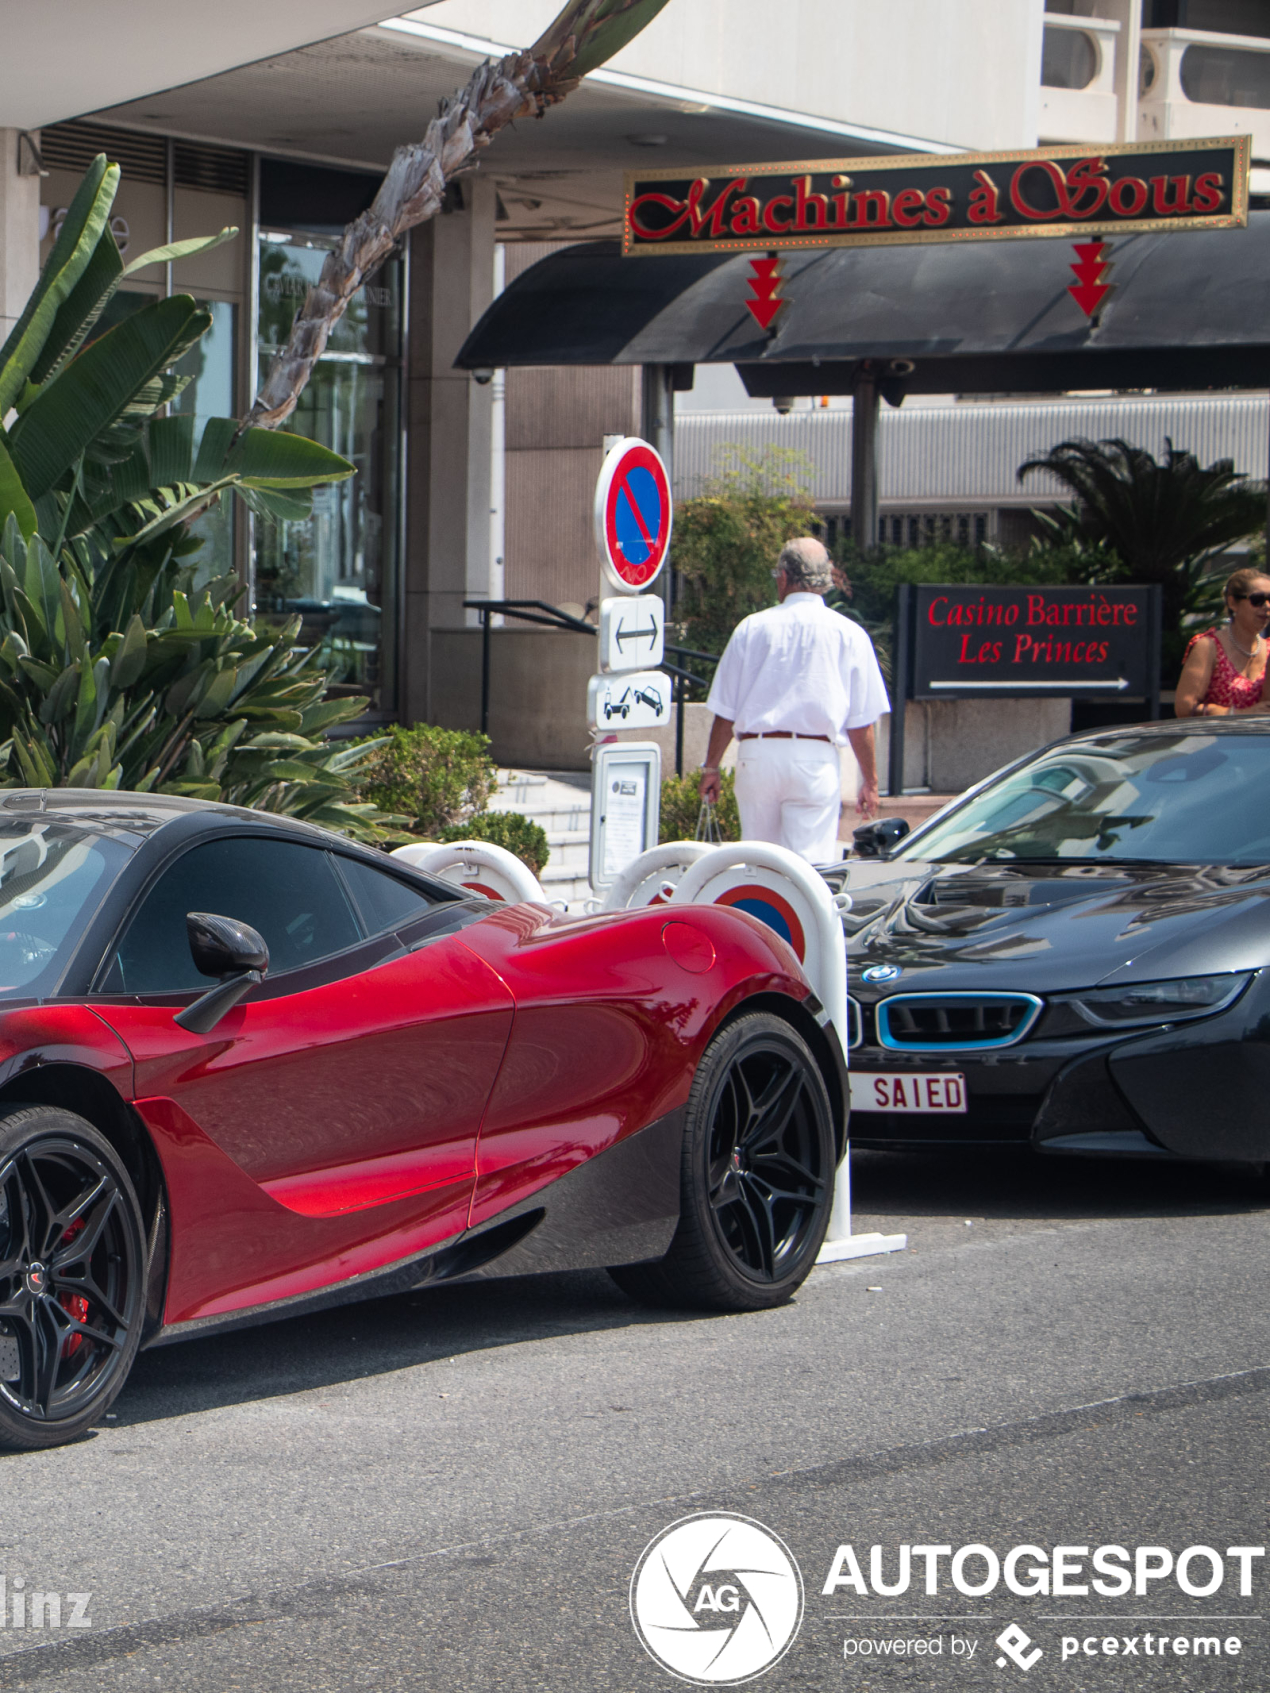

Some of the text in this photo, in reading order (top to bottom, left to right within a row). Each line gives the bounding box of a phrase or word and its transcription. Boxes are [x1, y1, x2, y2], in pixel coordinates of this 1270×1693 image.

[630, 156, 1225, 239] Machines à Sous
[928, 593, 1138, 627] Casino Barrière
[957, 633, 1110, 664] Les Princes
[874, 1077, 962, 1108] SAIED
